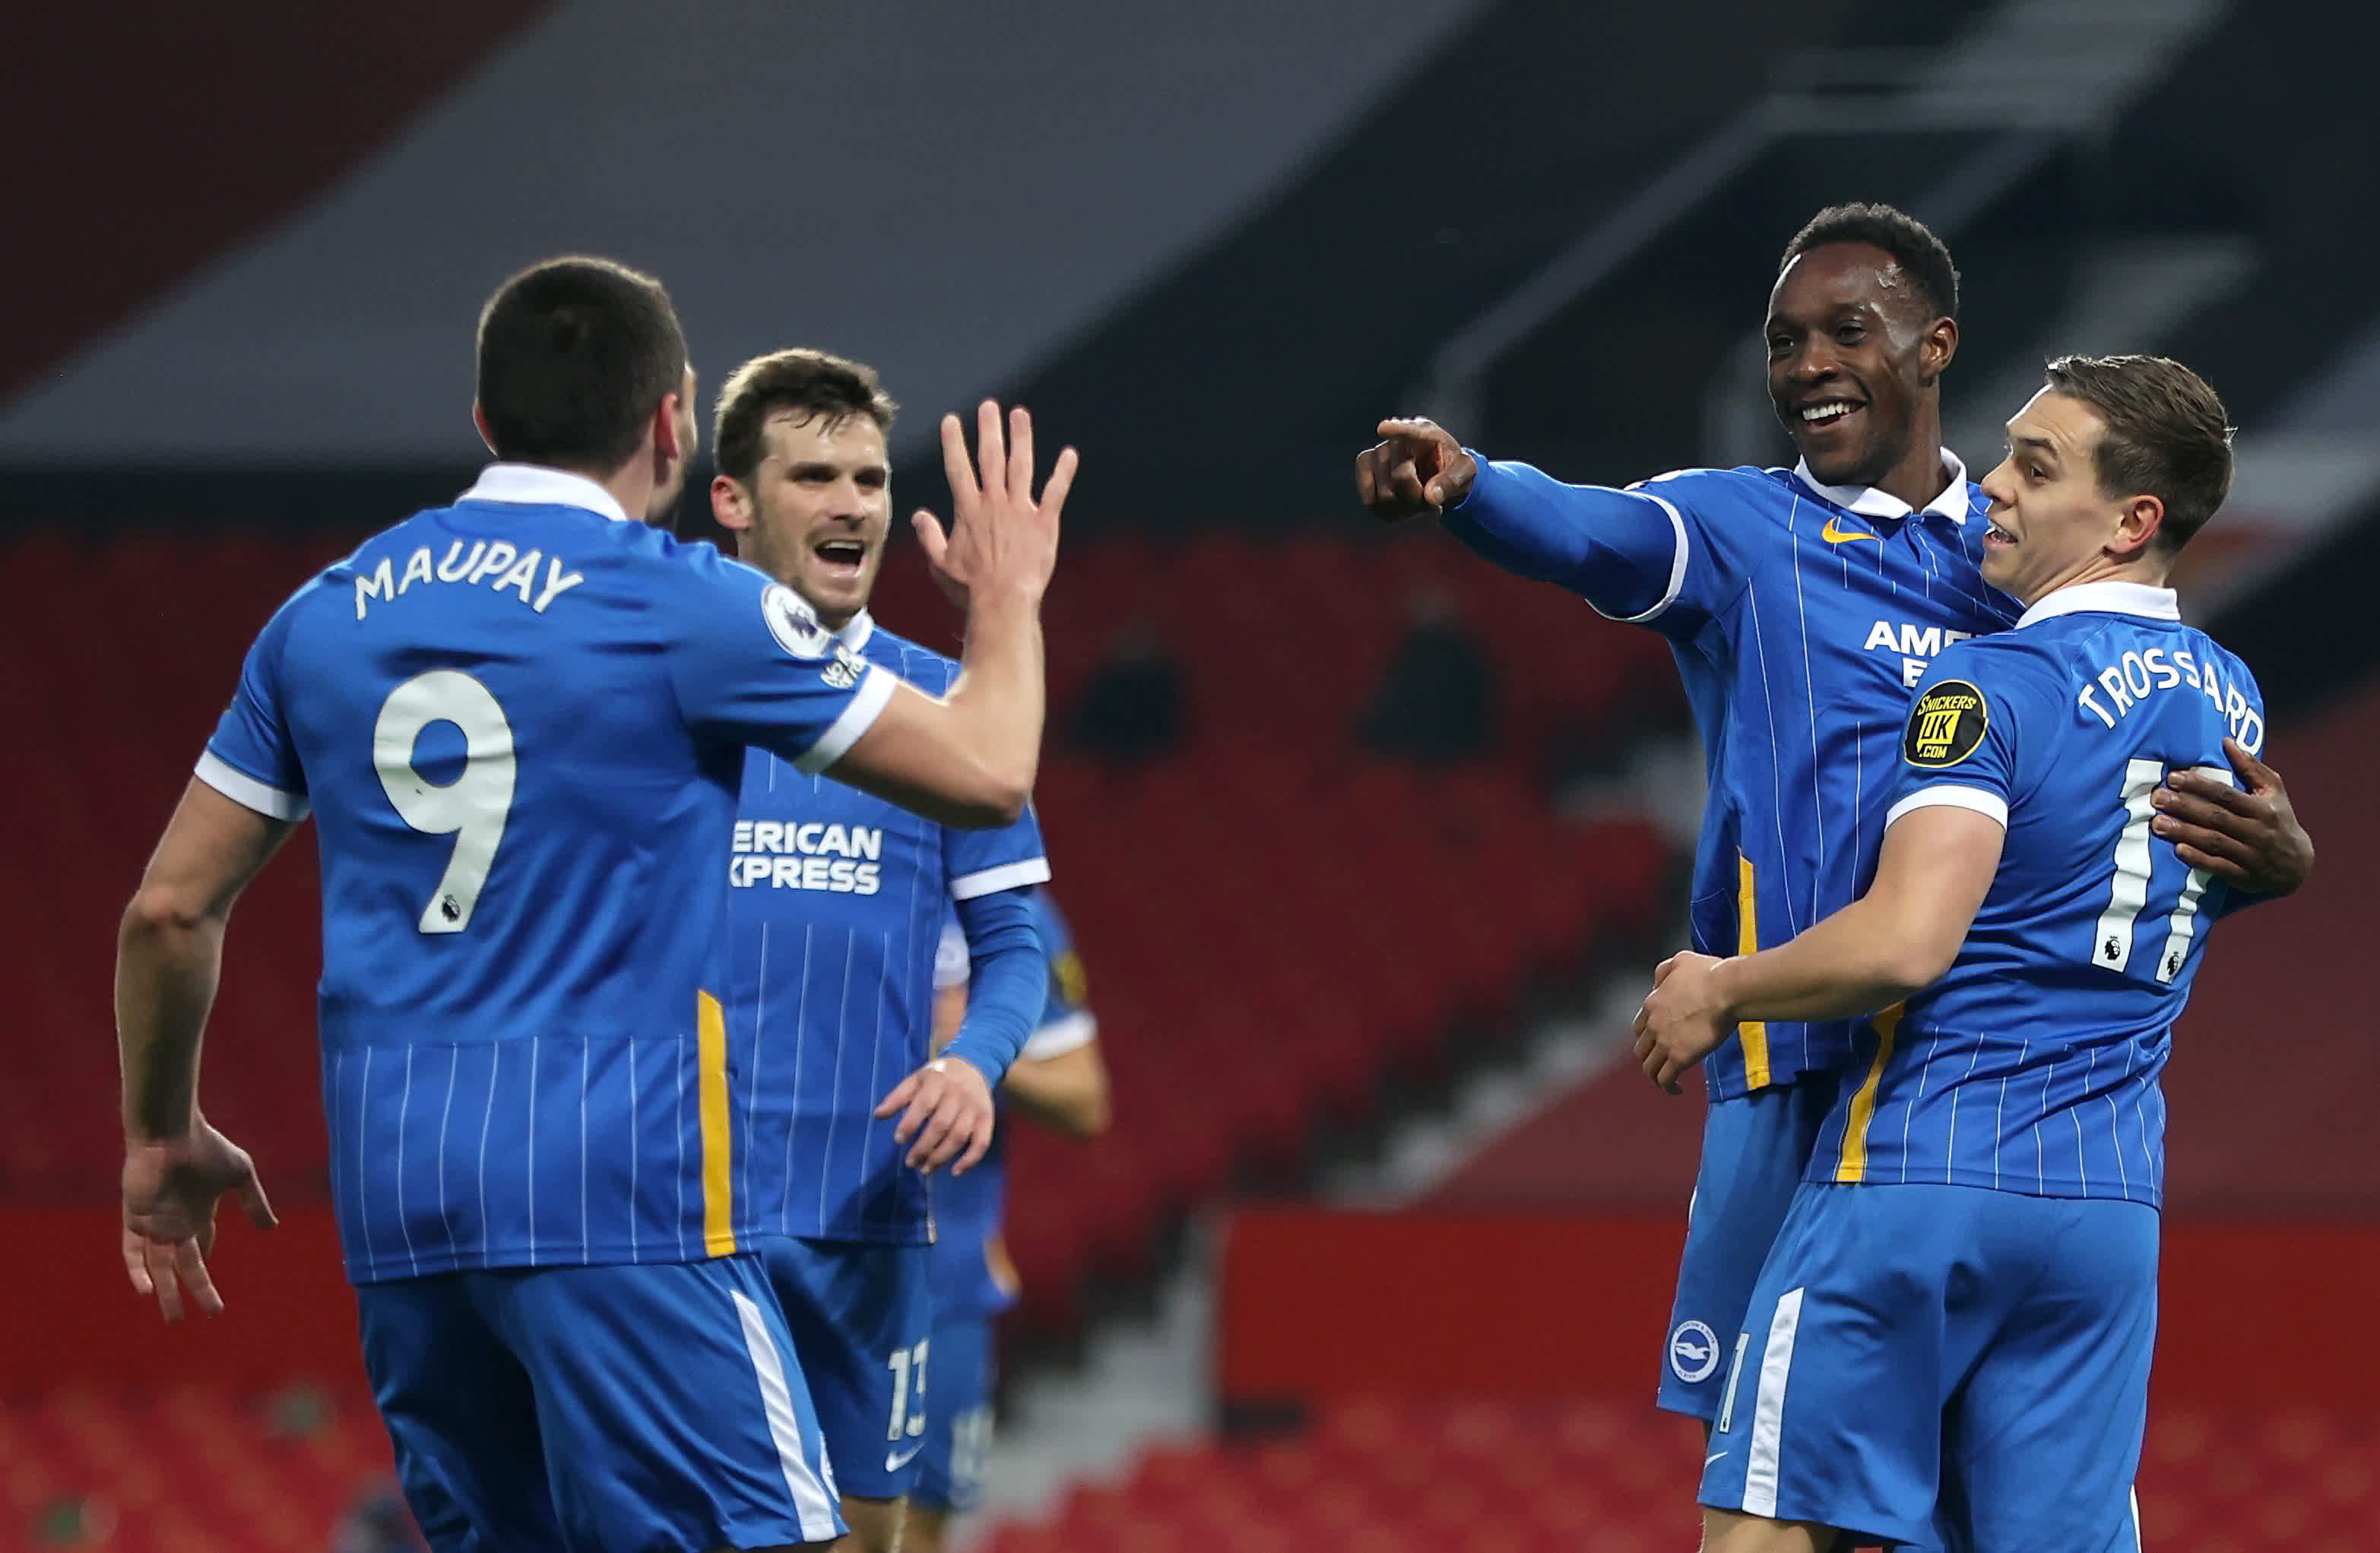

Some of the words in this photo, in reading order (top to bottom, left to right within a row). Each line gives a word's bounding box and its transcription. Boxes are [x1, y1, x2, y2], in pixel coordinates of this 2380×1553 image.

[355, 538, 585, 620] MAUPAY
[1917, 695, 1977, 716] SNICKERS
[2078, 648, 2264, 756] TROSSARD
[1921, 714, 1955, 740] UK
[1919, 745, 1947, 758] .COM
[372, 669, 517, 934] 9
[731, 819, 883, 860] ERICAN
